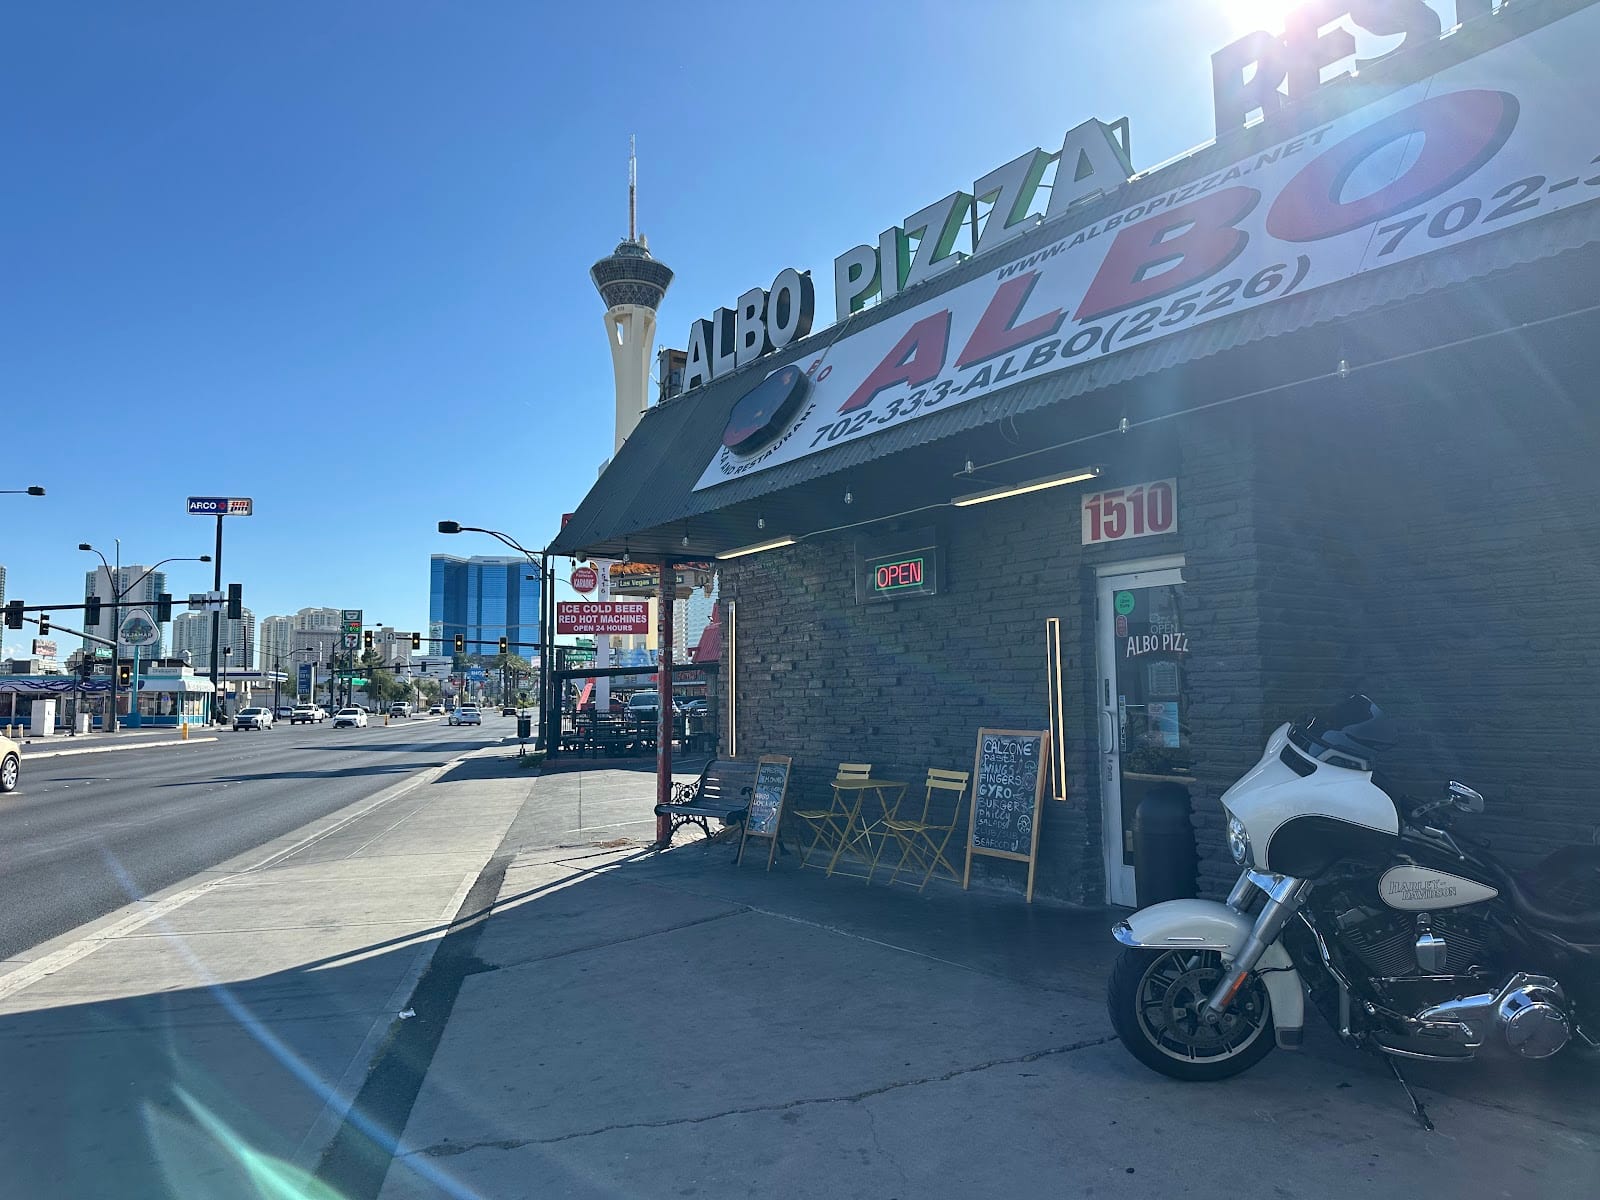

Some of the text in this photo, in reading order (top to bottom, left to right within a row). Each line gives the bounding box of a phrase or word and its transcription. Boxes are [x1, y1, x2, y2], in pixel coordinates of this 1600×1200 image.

[1211, 0, 1492, 141] RES
[997, 125, 1335, 282] WWW.ALBOPIZZA.NET
[682, 117, 1134, 394] ALBO PIZZA
[837, 89, 1520, 416] ALBO
[809, 254, 1310, 448] 702-333-ALBO(2526)
[735, 403, 817, 476] RESTAURANT
[190, 501, 217, 510] ARCO
[1084, 482, 1173, 541] 1510
[632, 579, 650, 587] Vegas
[877, 561, 921, 588] OPEN
[561, 604, 643, 613] ICE COLD BEER
[558, 615, 647, 624] RED HOT MACHINES
[1150, 623, 1178, 635] OPEN
[1126, 635, 1159, 658] ALBO
[983, 740, 1032, 756] CALZONE
[980, 773, 1022, 786] FINGERS
[979, 784, 1012, 799] GYRO
[1402, 887, 1457, 900] DAVIDSON
